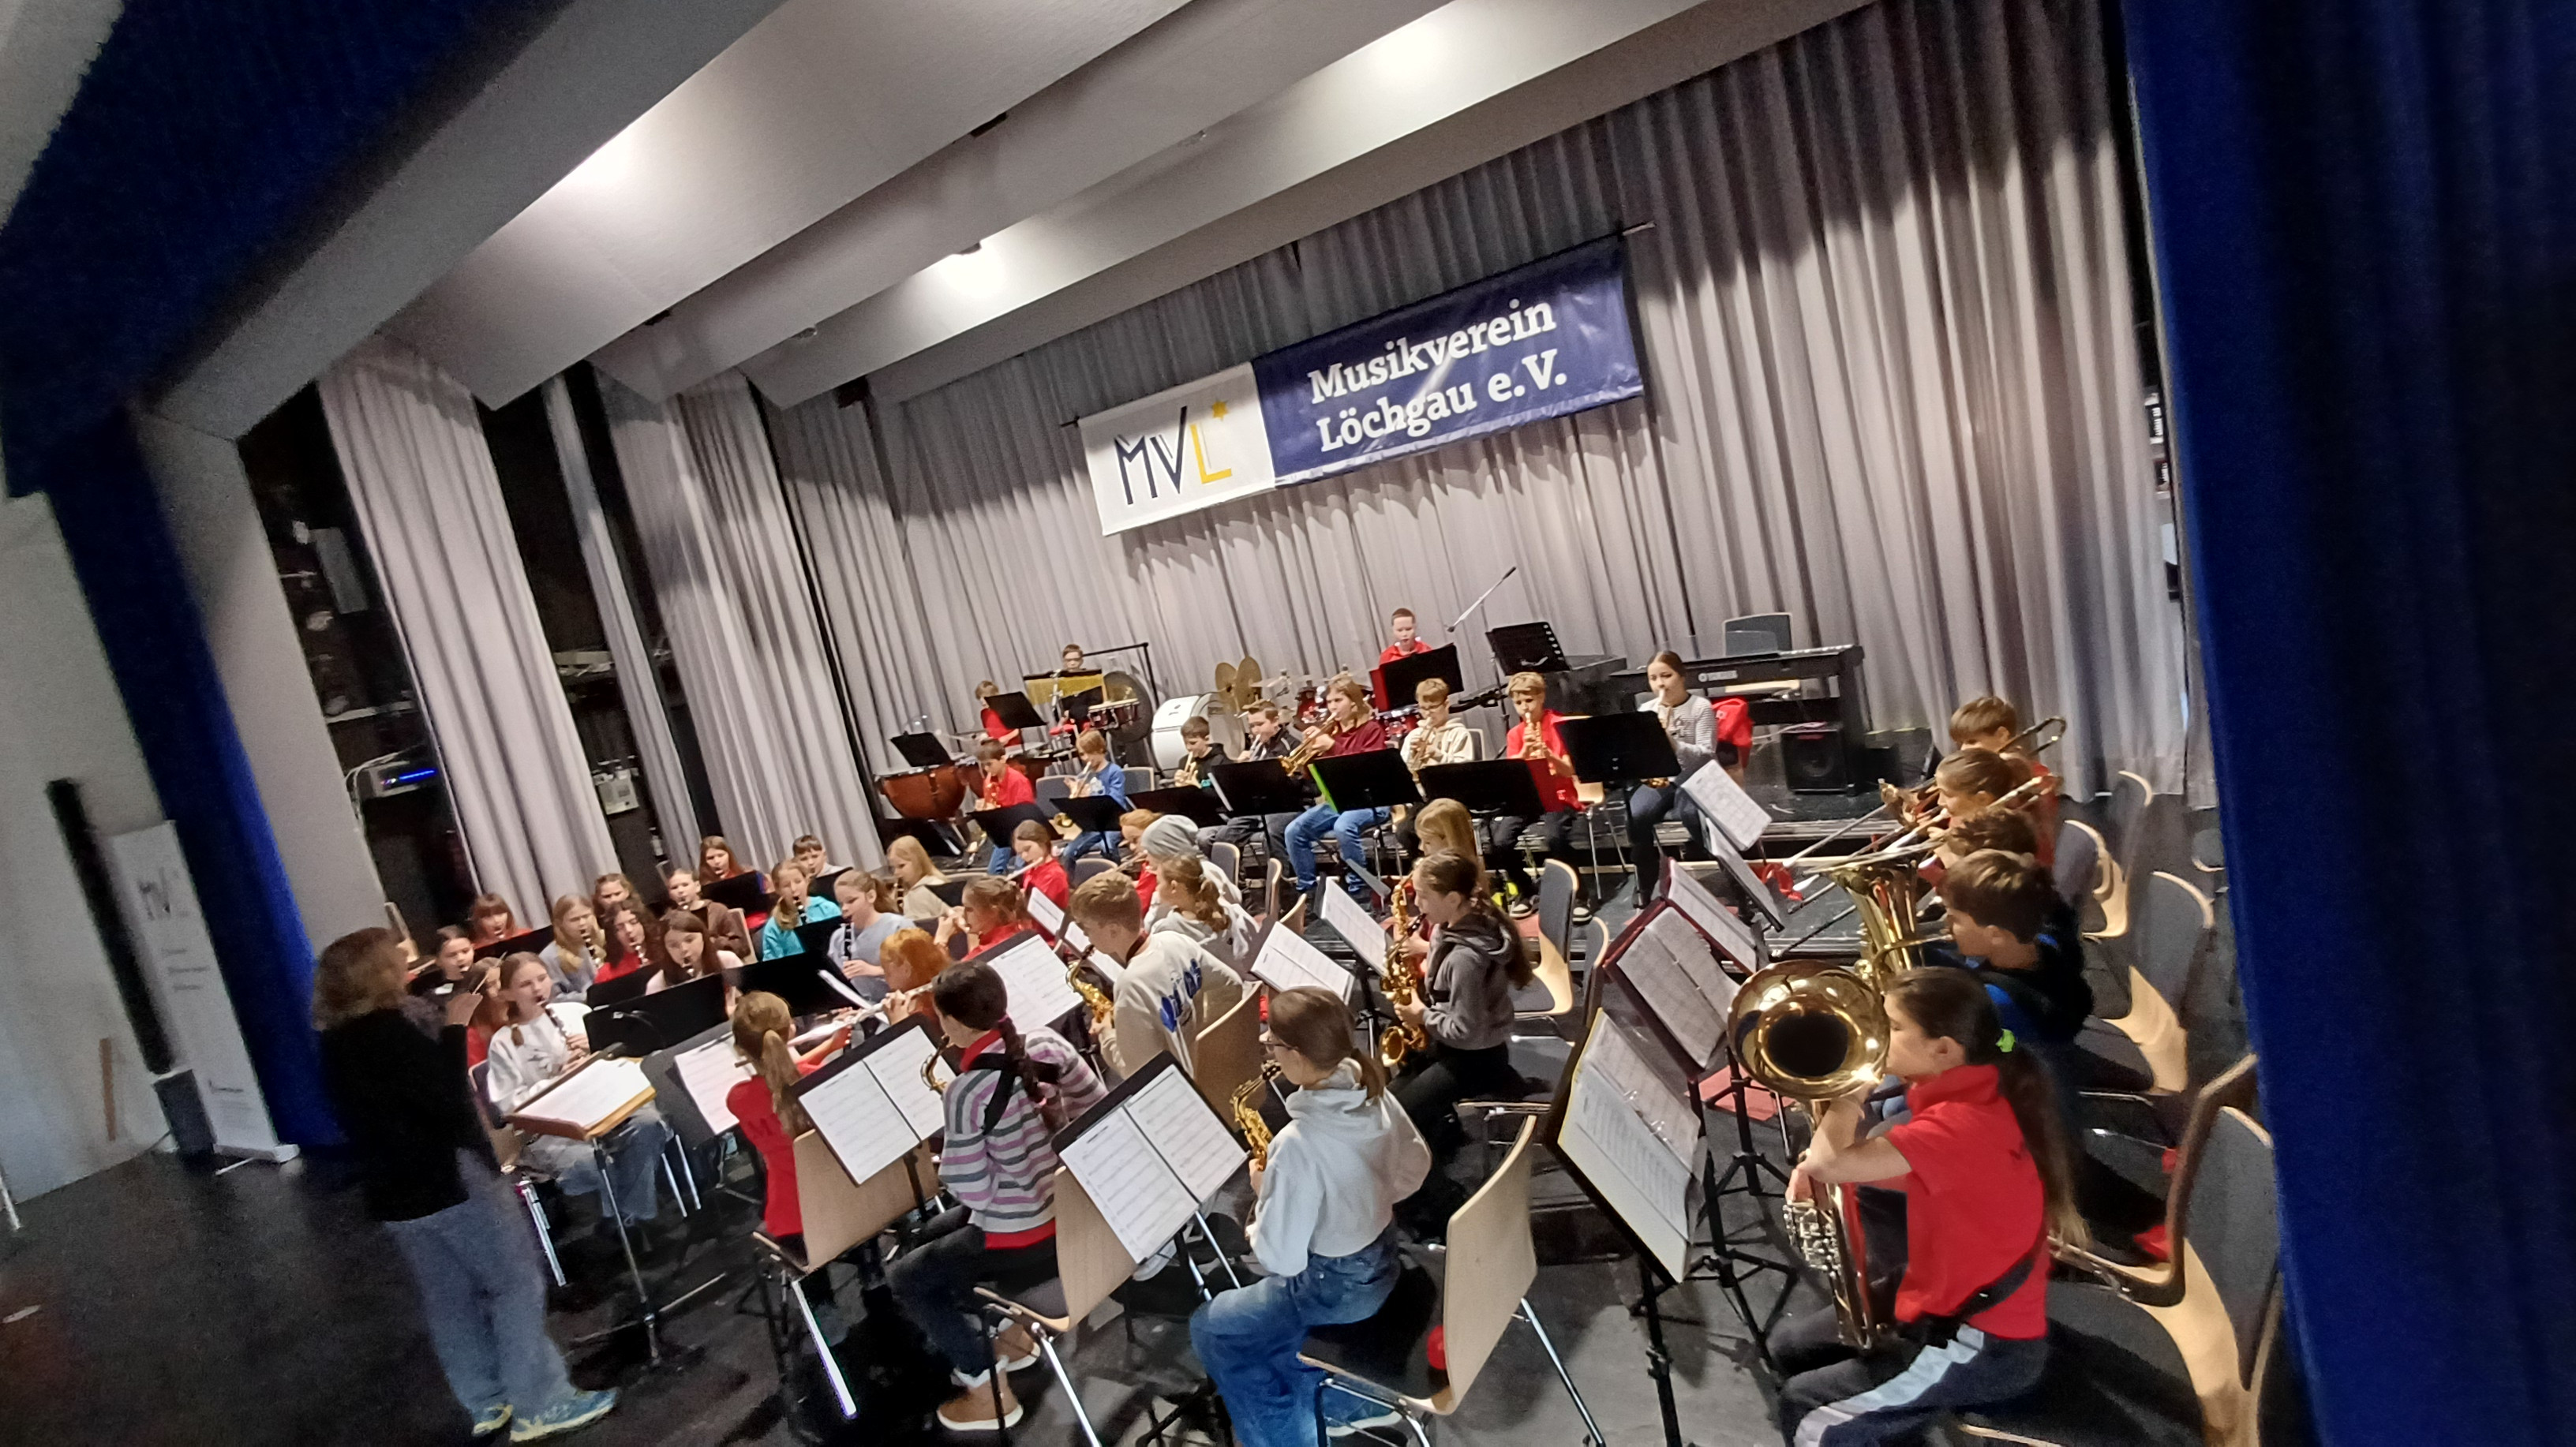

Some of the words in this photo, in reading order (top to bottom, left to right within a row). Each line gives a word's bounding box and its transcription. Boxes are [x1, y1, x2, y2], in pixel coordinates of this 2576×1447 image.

[1307, 298, 1557, 405] Musikverein
[1316, 382, 1478, 452] Löchgau
[1487, 348, 1567, 402] e.V.
[1114, 406, 1233, 505] MVL
